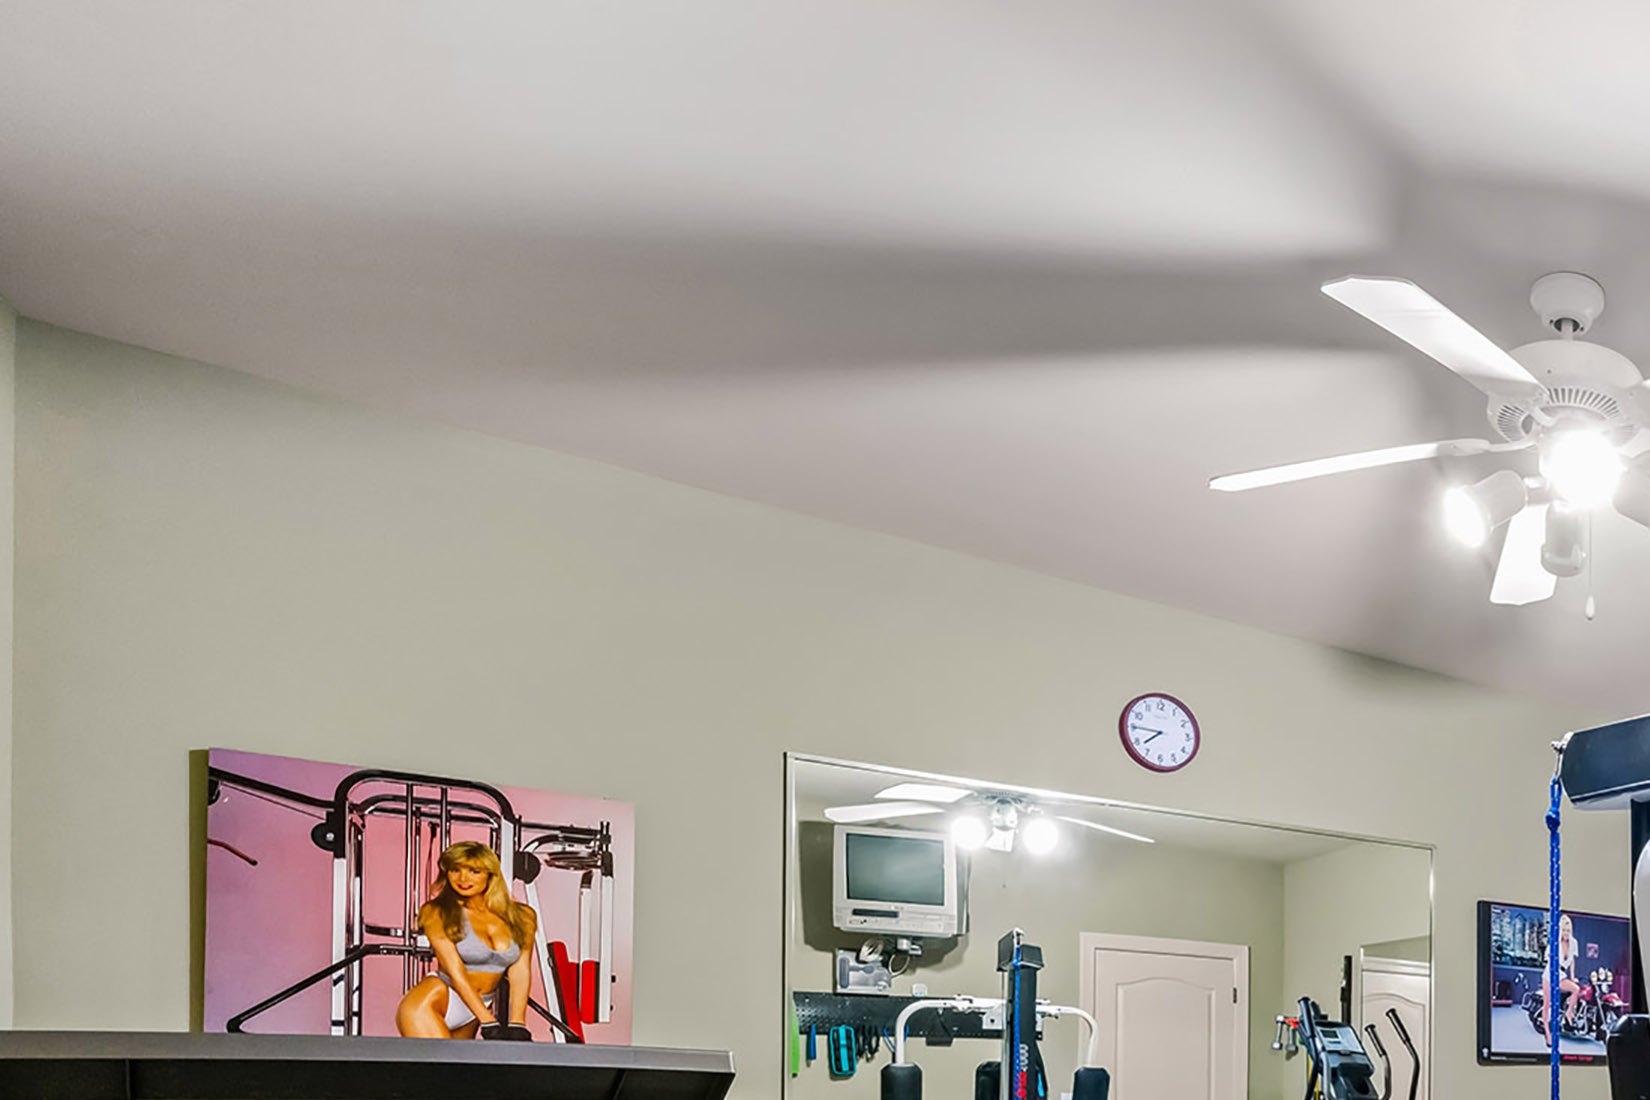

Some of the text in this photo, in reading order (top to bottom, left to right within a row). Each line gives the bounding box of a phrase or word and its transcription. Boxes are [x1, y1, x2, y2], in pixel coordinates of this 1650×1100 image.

[1145, 703, 1151, 712] 11
[1156, 702, 1166, 711] 12
[1135, 712, 1143, 720] 10
[1134, 737, 1140, 746] 8
[1157, 754, 1163, 763] 6
